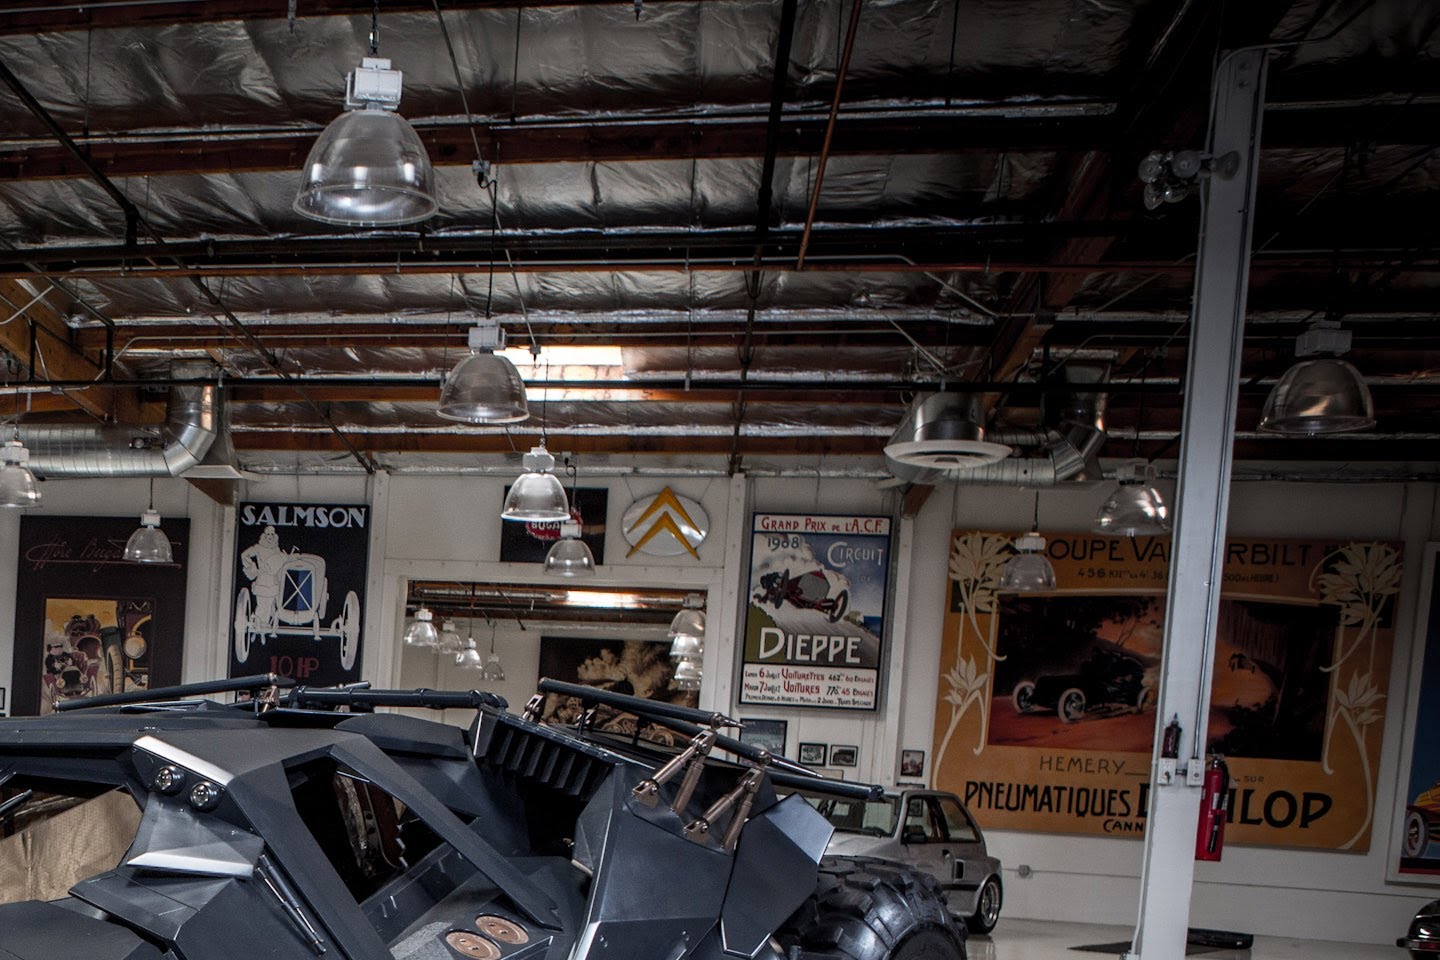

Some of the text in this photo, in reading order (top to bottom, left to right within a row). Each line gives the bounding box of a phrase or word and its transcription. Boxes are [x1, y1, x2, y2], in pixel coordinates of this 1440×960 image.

[241, 505, 367, 528] SALMSON
[761, 516, 800, 531] GRAND
[805, 518, 827, 532] PRIX
[767, 537, 800, 550] 1908
[826, 541, 884, 567] CIRCUIT
[1044, 538, 1124, 562] OUPE
[759, 626, 862, 664] DIEPPE
[270, 656, 294, 677] 10
[759, 667, 765, 678] 6
[782, 667, 825, 680] VOITURETTES
[783, 681, 820, 695] VOITURES
[1040, 755, 1126, 775] HEMERY
[965, 781, 1131, 818] PNEUMATIQUES
